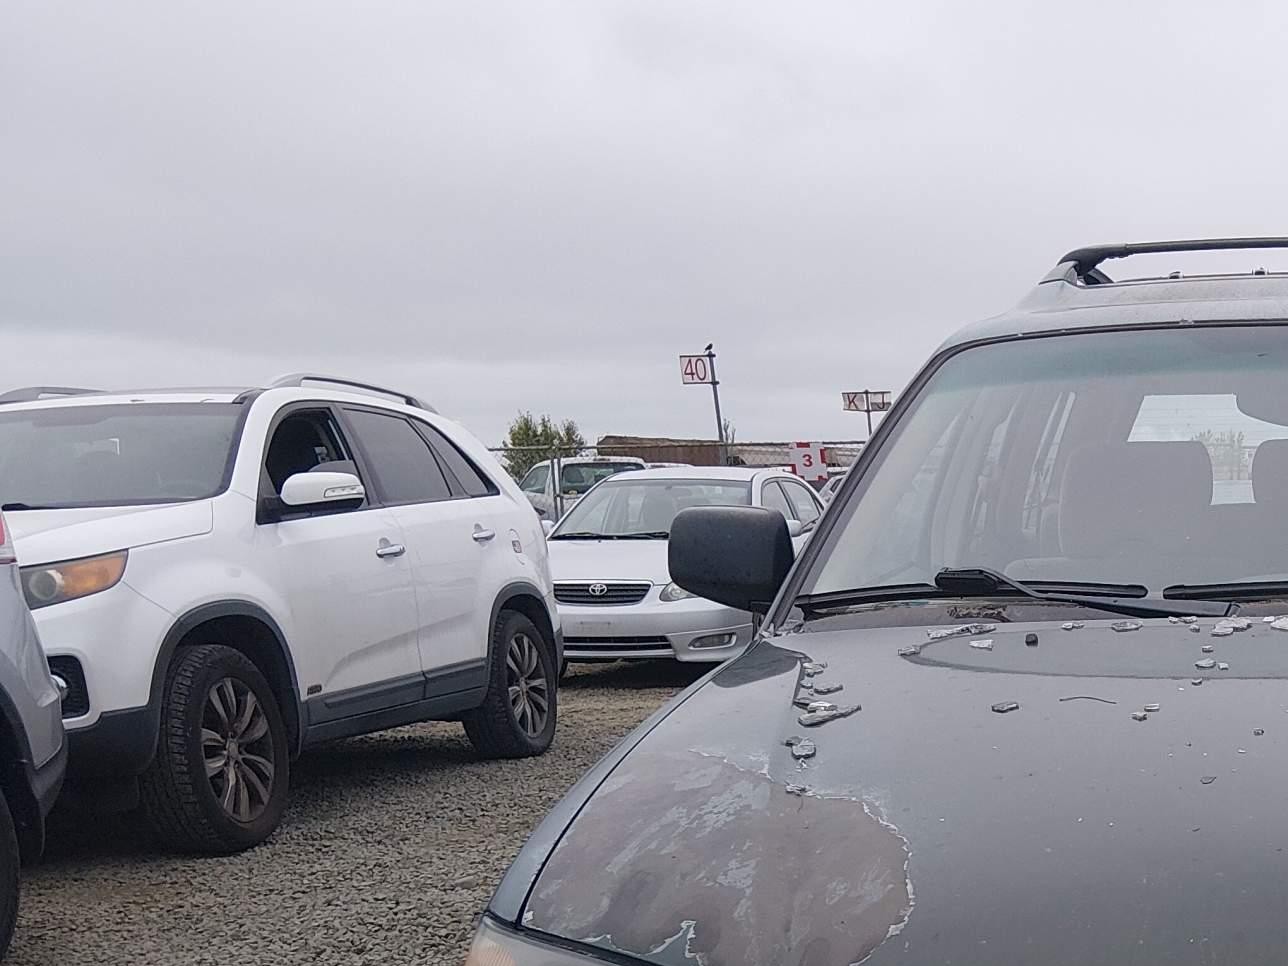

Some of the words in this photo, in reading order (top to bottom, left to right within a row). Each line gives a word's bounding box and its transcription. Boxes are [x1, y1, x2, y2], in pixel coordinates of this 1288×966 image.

[683, 358, 707, 381] 40
[847, 393, 859, 409] K
[876, 392, 886, 409] J
[801, 453, 813, 468] 3
